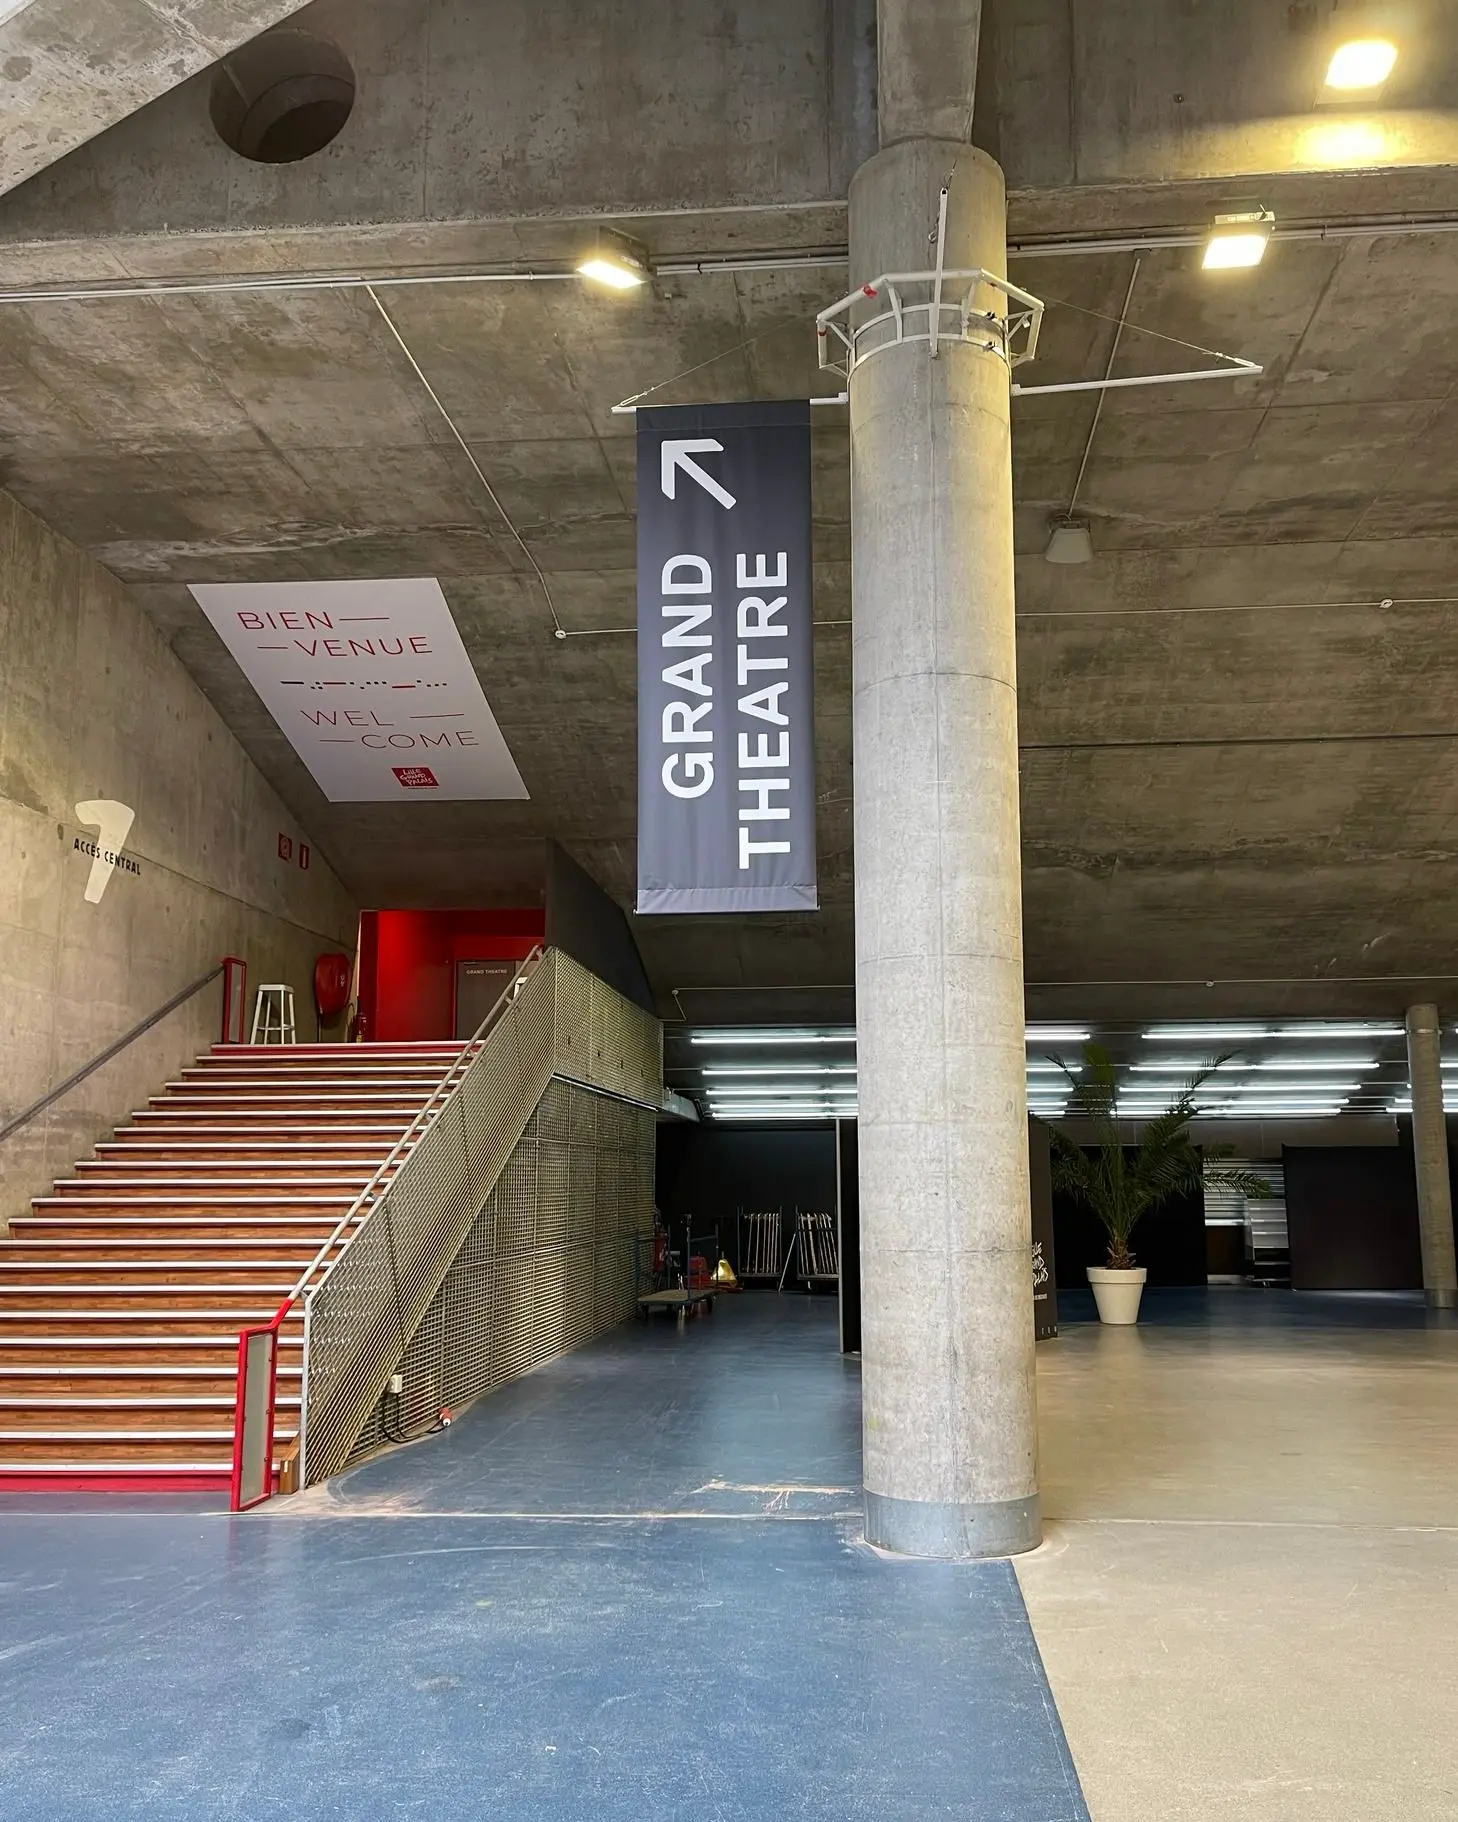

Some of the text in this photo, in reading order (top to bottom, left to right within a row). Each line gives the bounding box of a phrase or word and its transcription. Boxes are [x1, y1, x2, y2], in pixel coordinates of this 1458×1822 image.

[236, 611, 335, 631] BIEN
[293, 636, 434, 658] VENUE
[661, 553, 715, 799] GRAND
[300, 710, 395, 727] WEL
[736, 552, 791, 870] THEATRE
[360, 730, 480, 750] COME
[104, 851, 141, 876] CENTRAL
